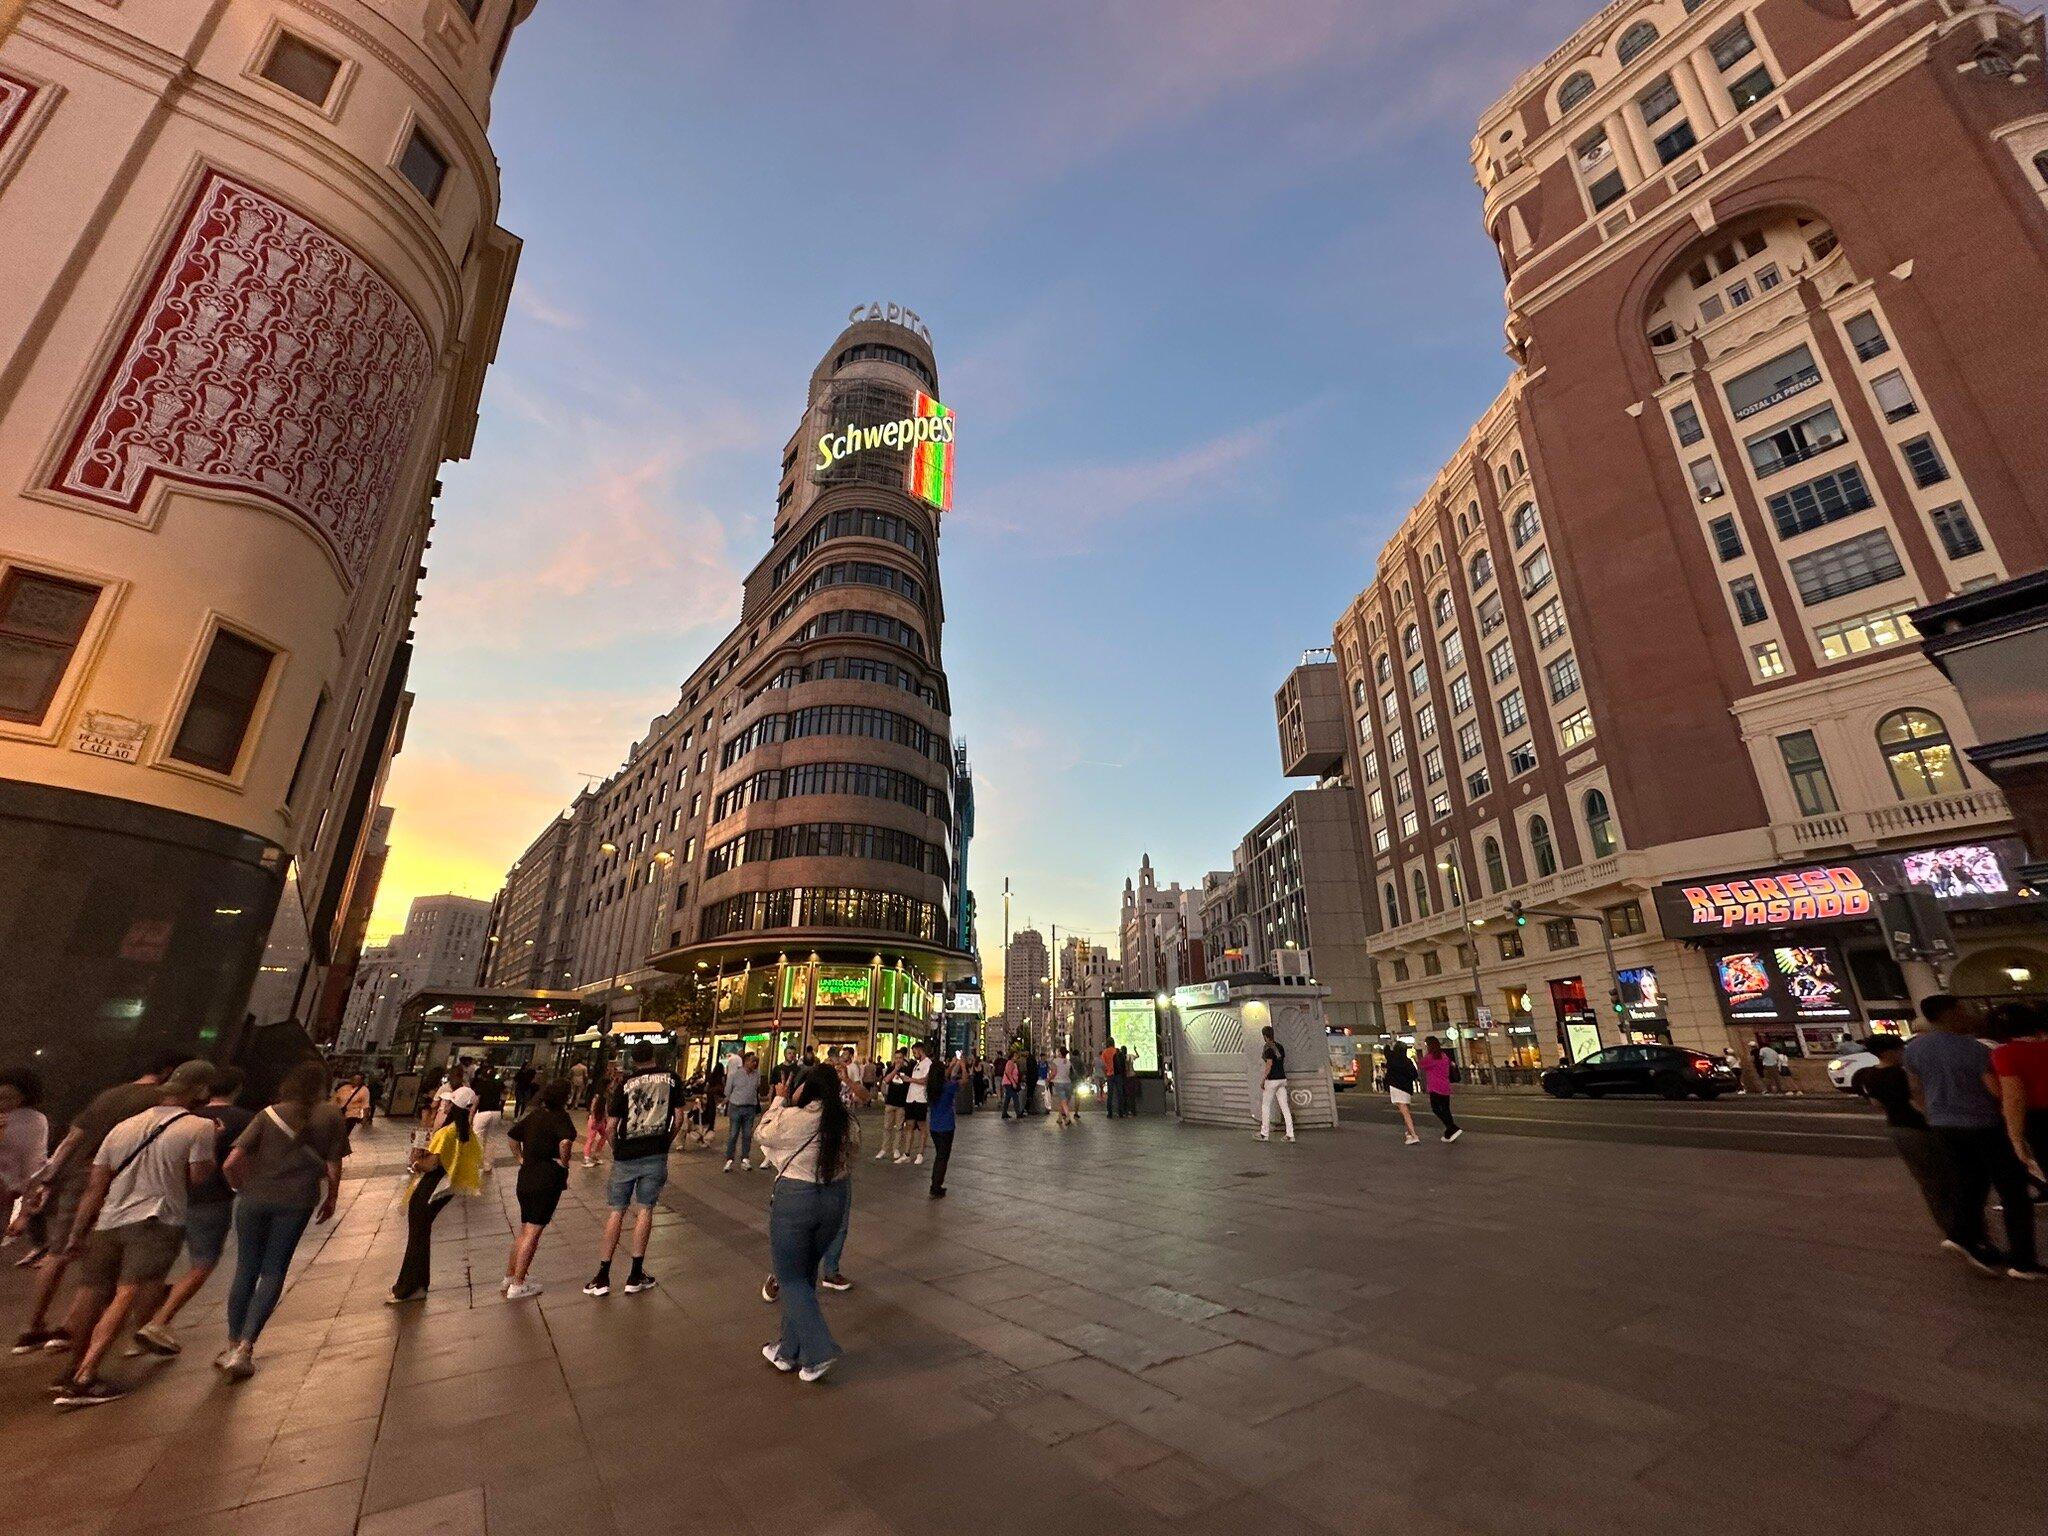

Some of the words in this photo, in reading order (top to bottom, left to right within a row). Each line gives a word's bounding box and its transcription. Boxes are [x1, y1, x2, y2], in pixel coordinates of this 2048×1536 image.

[1736, 399, 1771, 417] HOSTAL
[1770, 392, 1783, 403] LA
[1782, 375, 1820, 397] PRENSA
[816, 416, 953, 471] Schweppes
[79, 733, 112, 746] PLAZA
[80, 742, 129, 758] CALLAO
[1681, 866, 1863, 910] REGRESO
[1693, 907, 1722, 924] AL
[1722, 889, 1870, 928] PASADO
